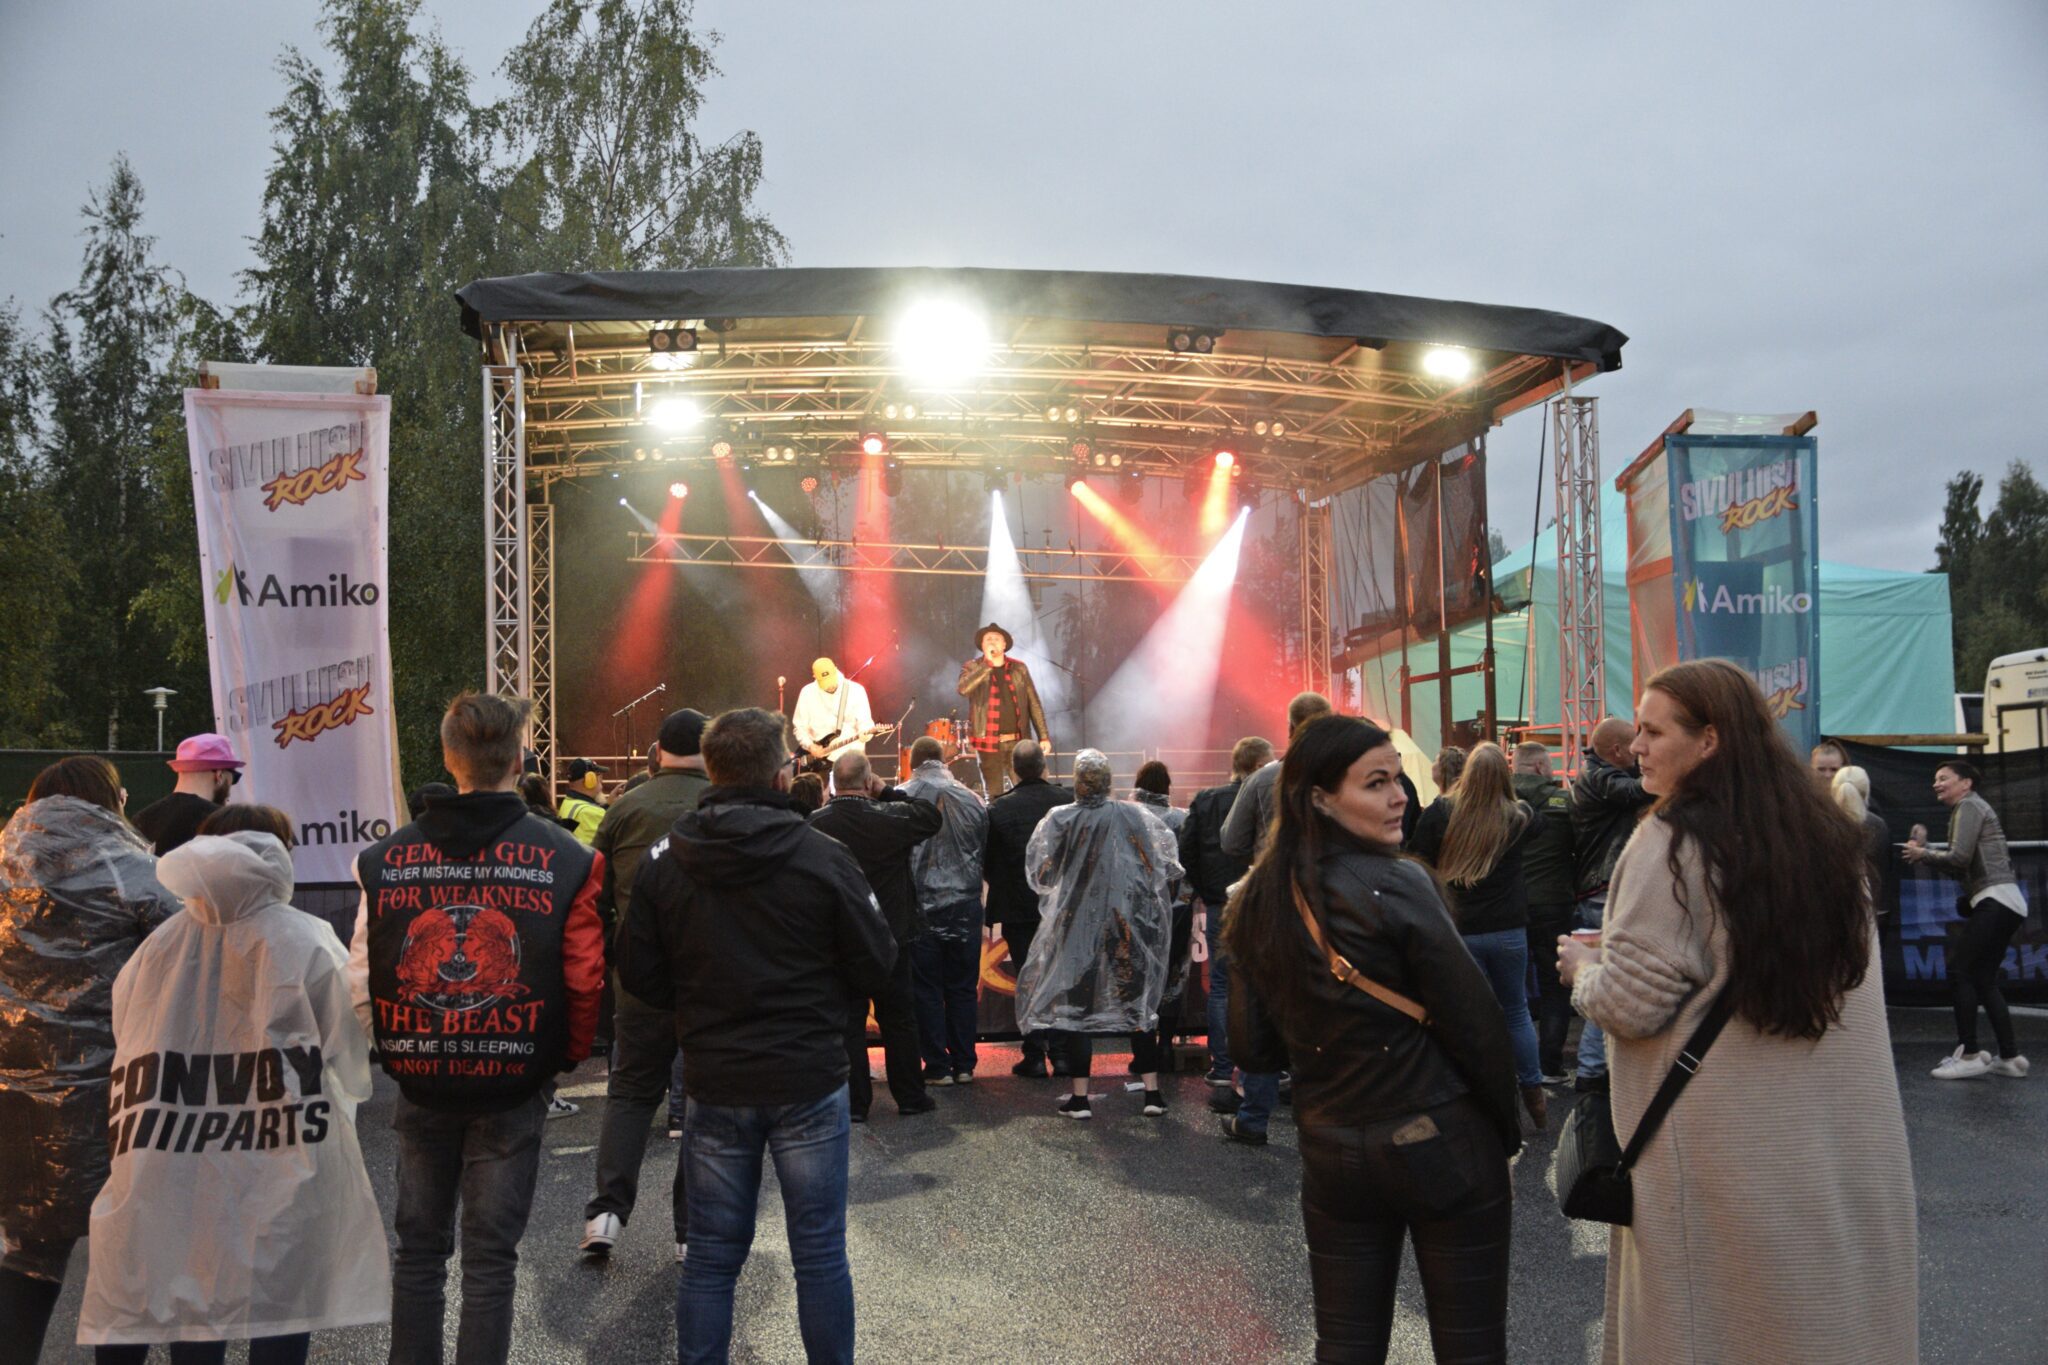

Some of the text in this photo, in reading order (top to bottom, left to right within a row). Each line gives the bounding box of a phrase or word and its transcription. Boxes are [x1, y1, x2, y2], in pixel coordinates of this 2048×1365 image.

[261, 448, 366, 512] ROCK
[1717, 482, 1799, 535] ROCK
[257, 573, 379, 607] Amiko
[1711, 585, 1812, 614] Amiko
[272, 682, 374, 749] ROCK
[495, 841, 555, 870] GUY
[382, 865, 554, 884] NEVER MISTAKE MY KINDNESS
[377, 885, 553, 918] FOR WEAKNESS
[376, 998, 544, 1034] THE BEAST
[419, 1040, 438, 1053] ME
[444, 1041, 456, 1053] IS
[461, 1041, 535, 1055] SLEEPING
[109, 1045, 322, 1115] CONVOY
[403, 1058, 502, 1077] NOT DEAD
